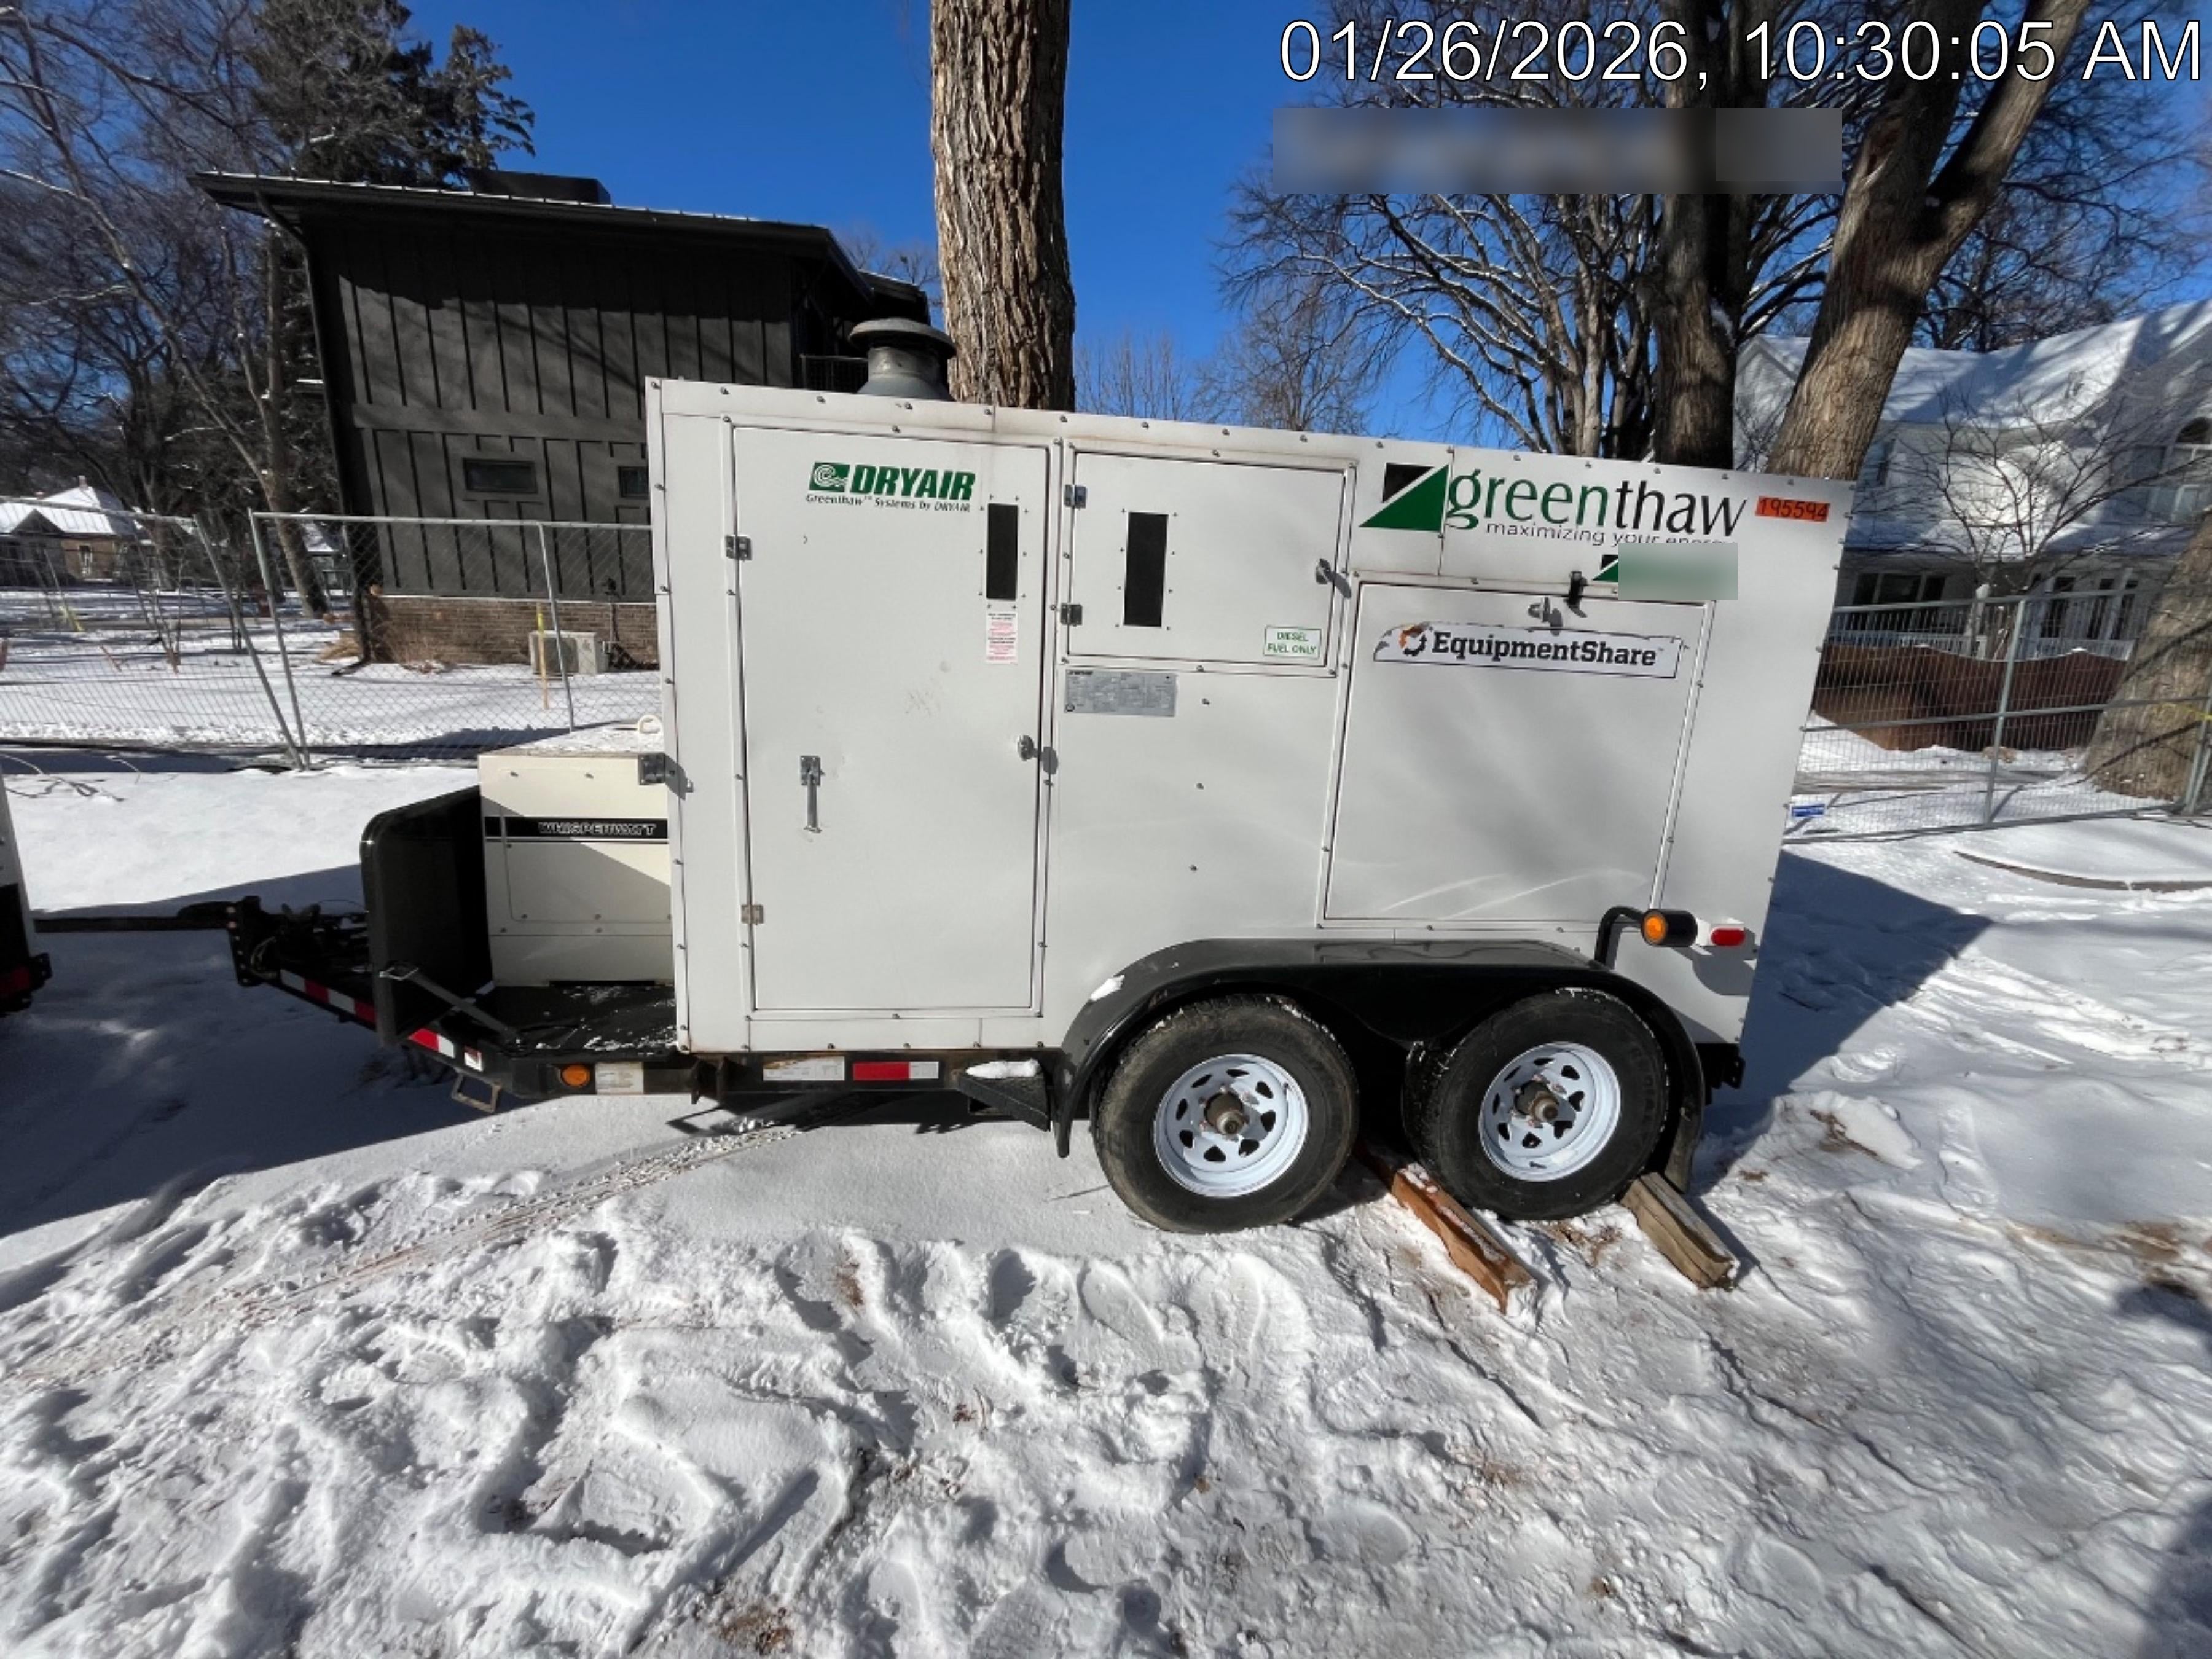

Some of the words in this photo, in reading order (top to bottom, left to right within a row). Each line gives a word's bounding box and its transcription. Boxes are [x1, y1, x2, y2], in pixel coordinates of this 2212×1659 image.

[850, 464, 976, 501] DRYAIR
[874, 497, 916, 510] Systems
[919, 500, 931, 511] by
[1445, 469, 1748, 537] greenthaw
[1759, 497, 1829, 522] 195594
[1485, 522, 1605, 546] maximizing
[1267, 642, 1289, 654] FUEL
[1431, 630, 1657, 666] EquipmentShare
